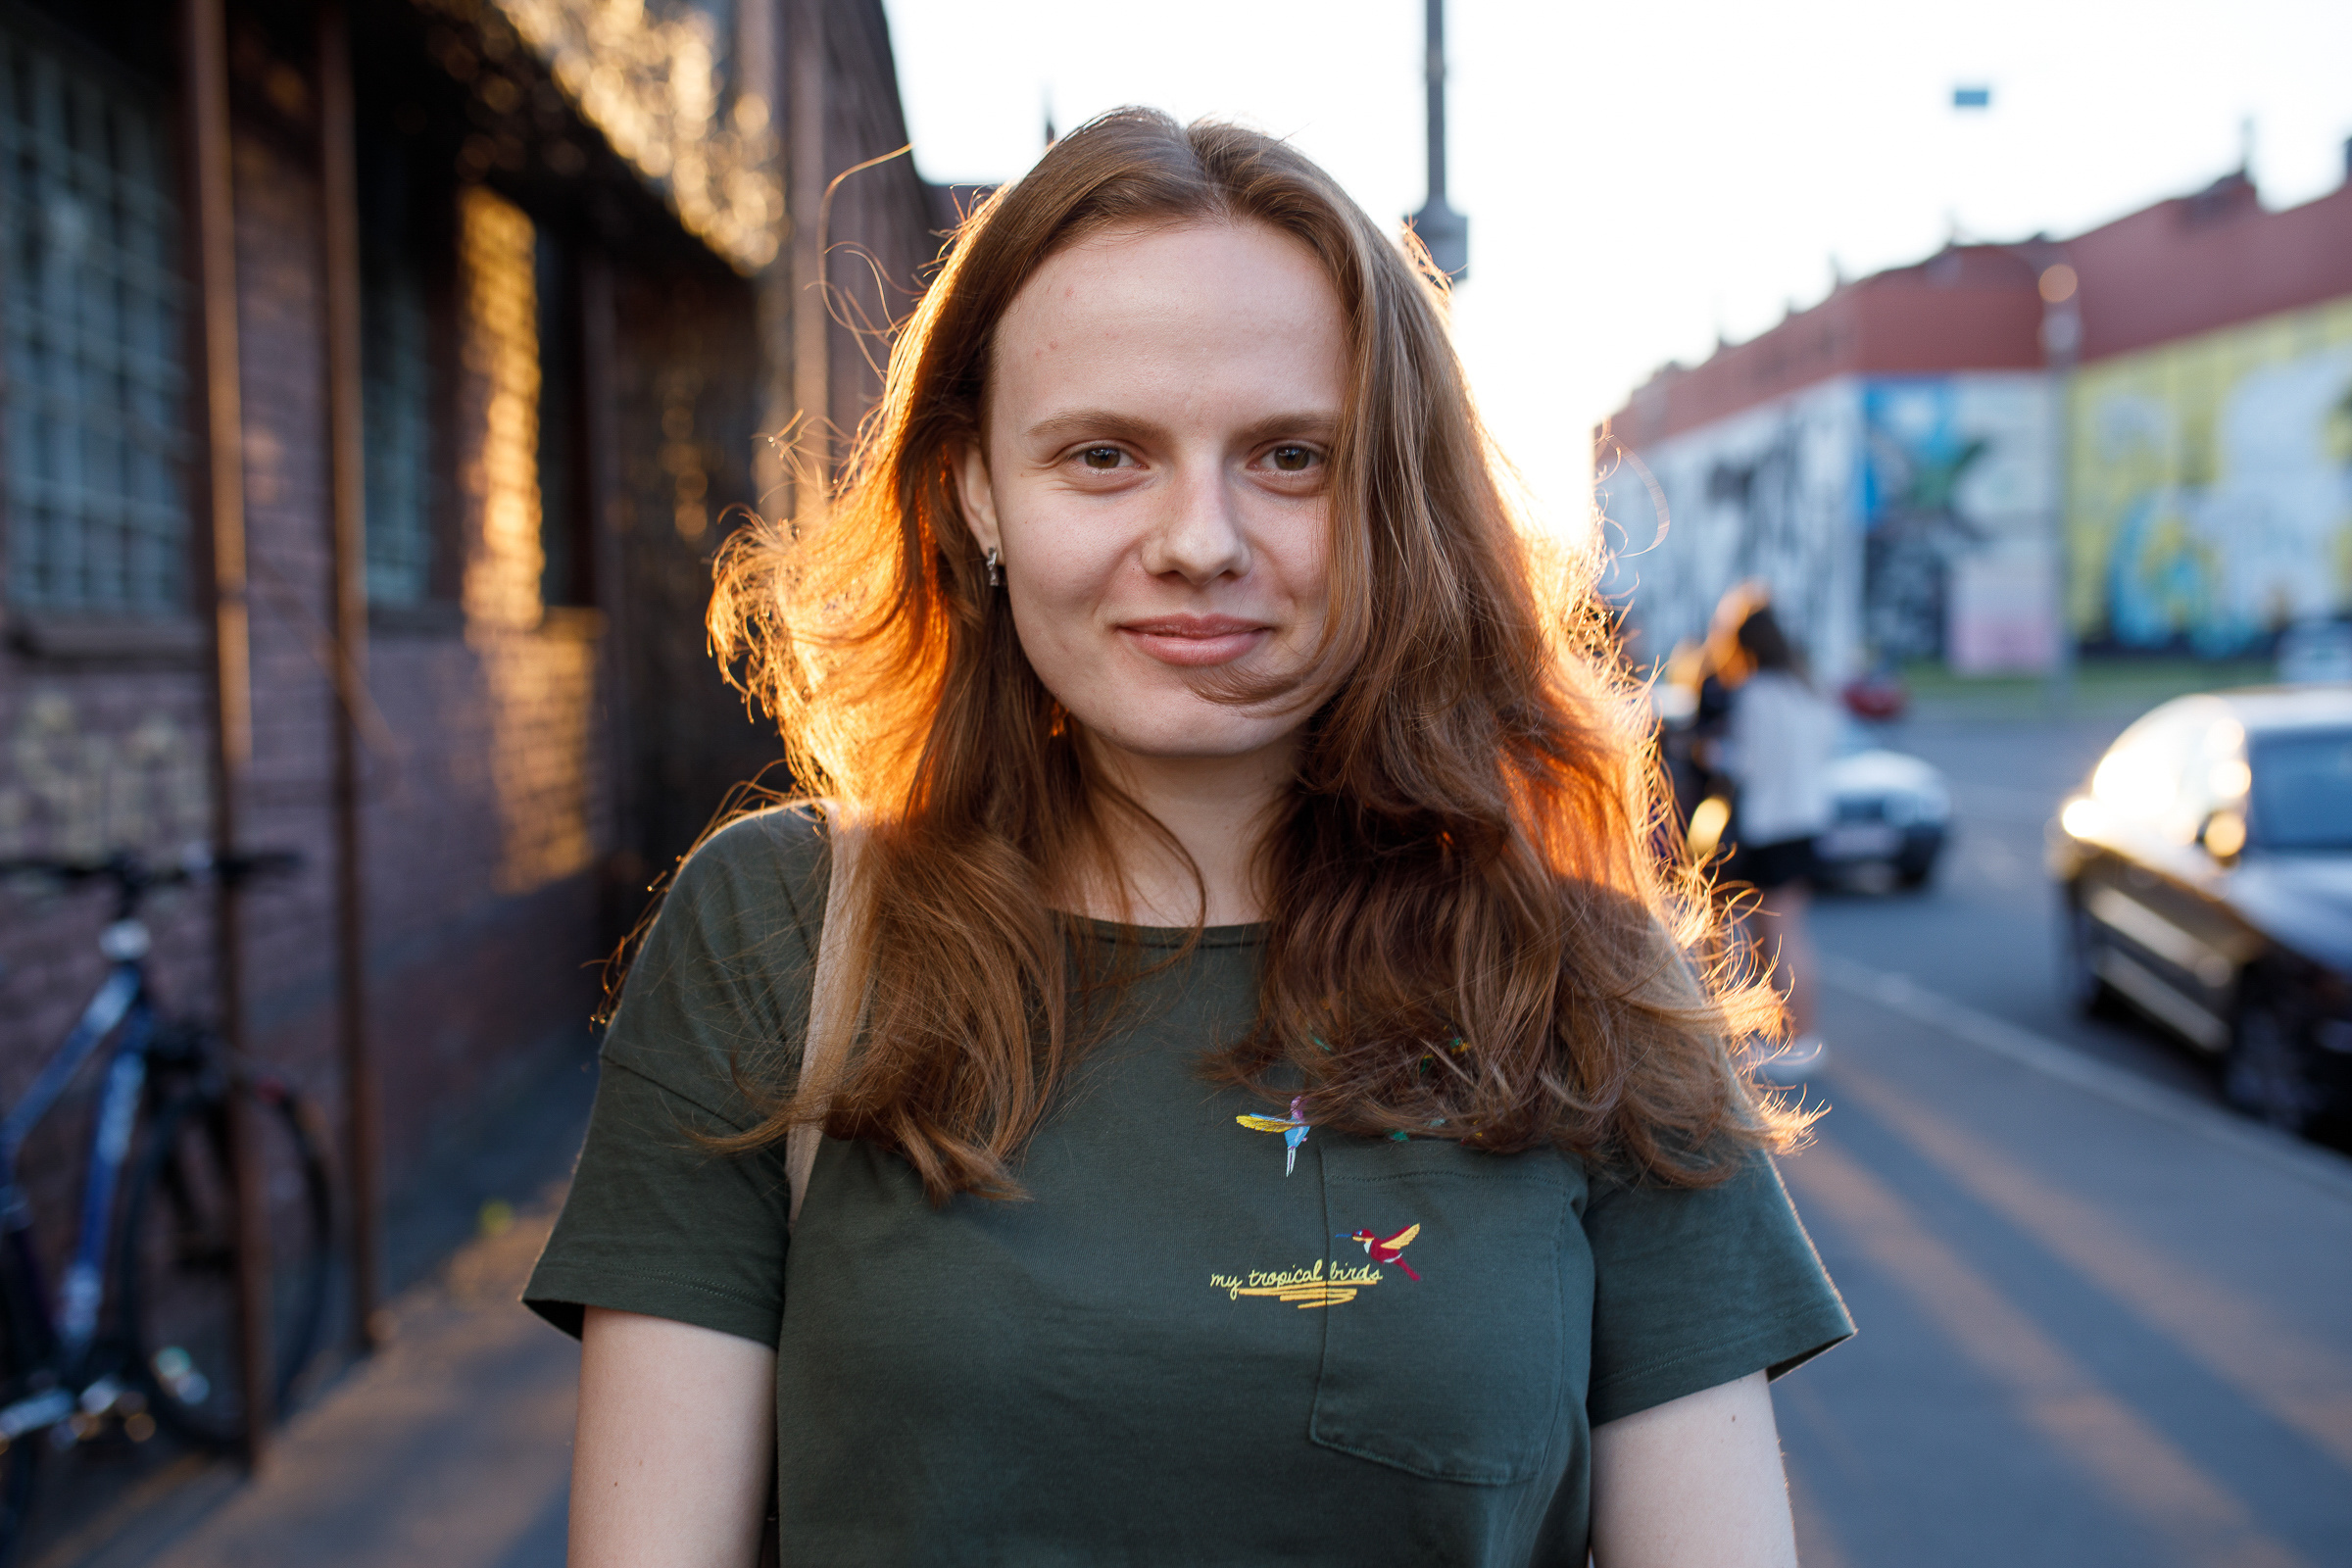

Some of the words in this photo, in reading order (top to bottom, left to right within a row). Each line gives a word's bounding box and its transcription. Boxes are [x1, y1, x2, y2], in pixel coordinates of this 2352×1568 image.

[1209, 1272, 1243, 1300] my
[1248, 1258, 1324, 1289] tropical
[1329, 1260, 1384, 1281] birds
